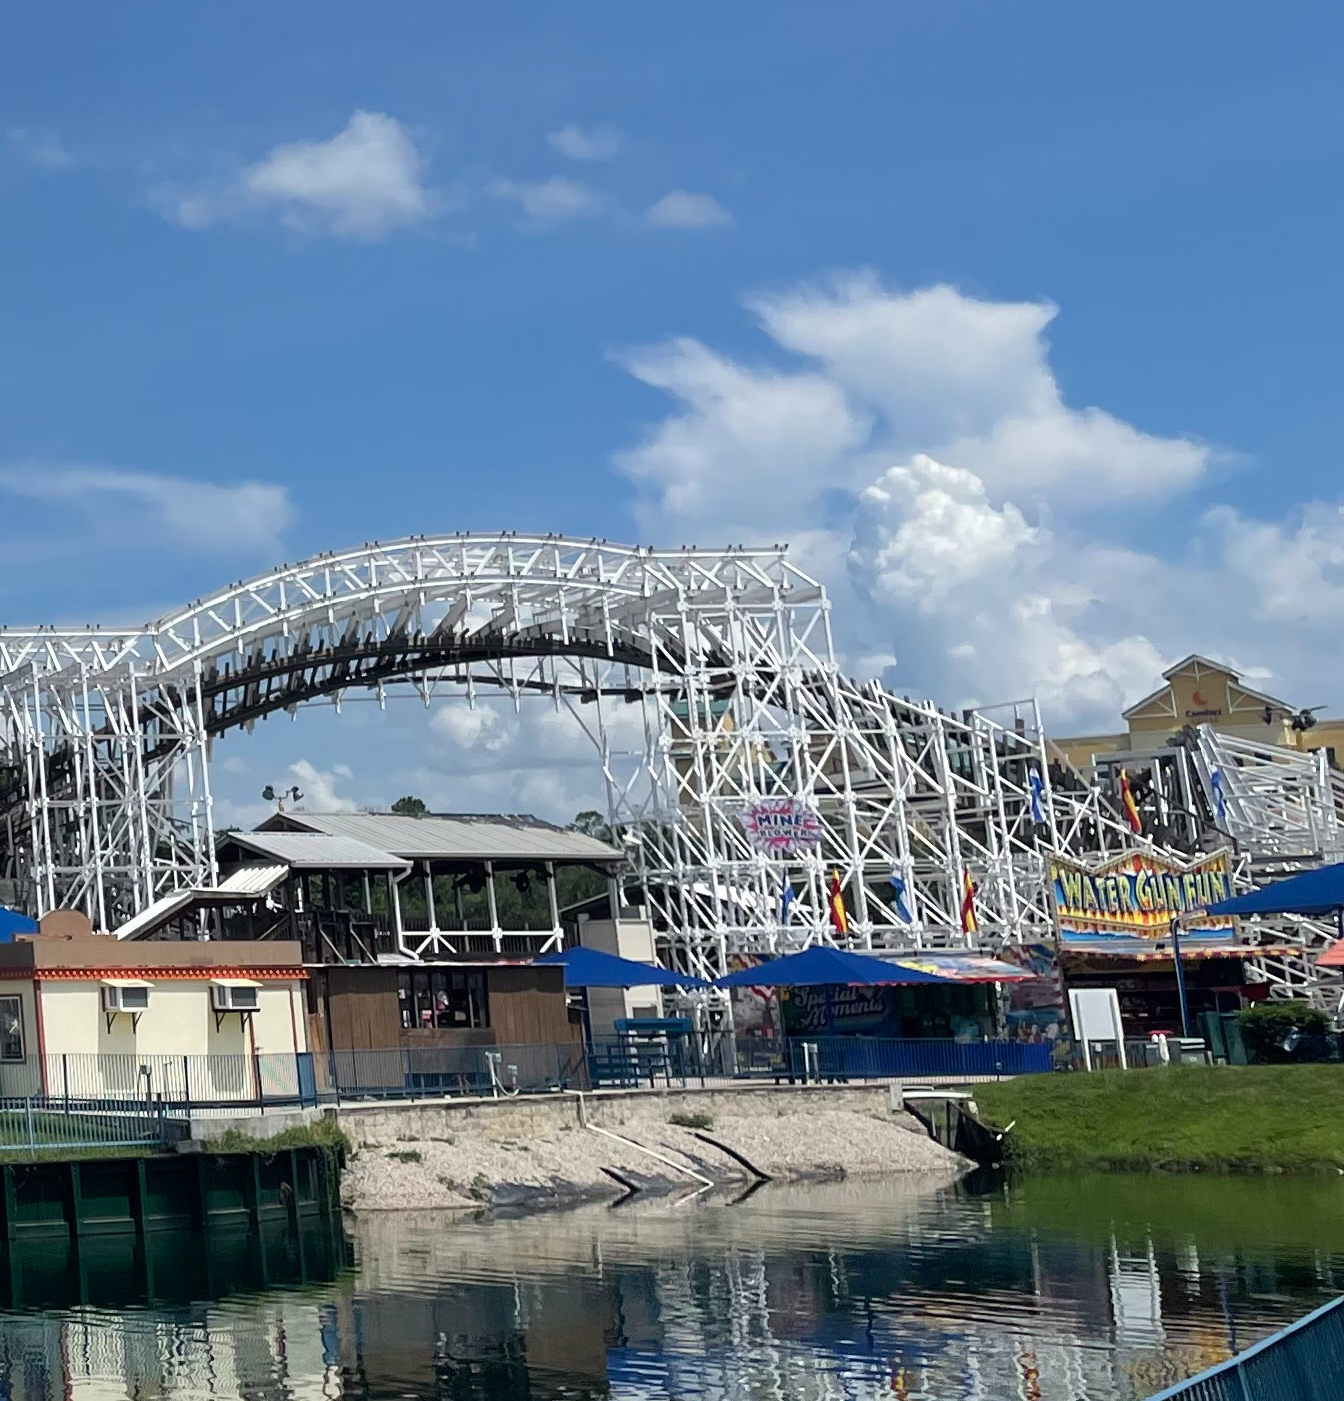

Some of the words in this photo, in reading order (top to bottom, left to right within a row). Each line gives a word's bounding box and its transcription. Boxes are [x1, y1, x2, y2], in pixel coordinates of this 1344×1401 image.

[757, 814, 803, 827] MINE
[1059, 869, 1137, 911] WATER
[1136, 868, 1183, 911] GUN
[1183, 871, 1226, 911] FUN
[793, 985, 857, 1012] Speial
[800, 999, 884, 1026] Mments
